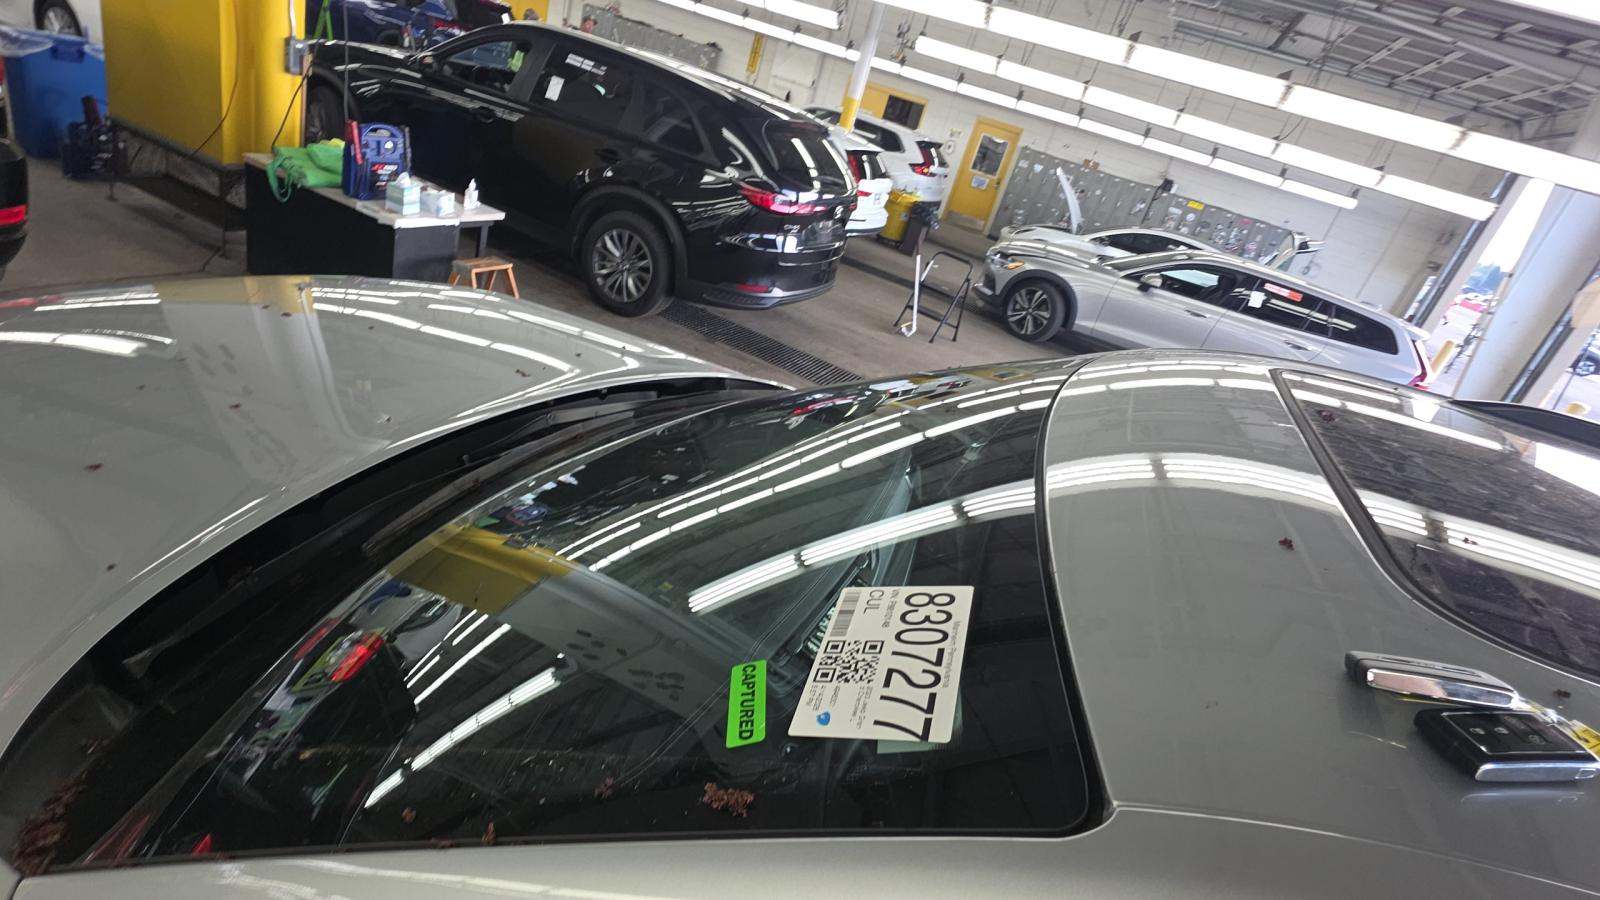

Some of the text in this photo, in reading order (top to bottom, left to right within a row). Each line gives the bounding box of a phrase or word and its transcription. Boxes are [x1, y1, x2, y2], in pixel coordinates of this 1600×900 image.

[863, 589, 884, 615] CUL
[738, 664, 757, 740] CAPTURED
[873, 592, 956, 742] 8307277
